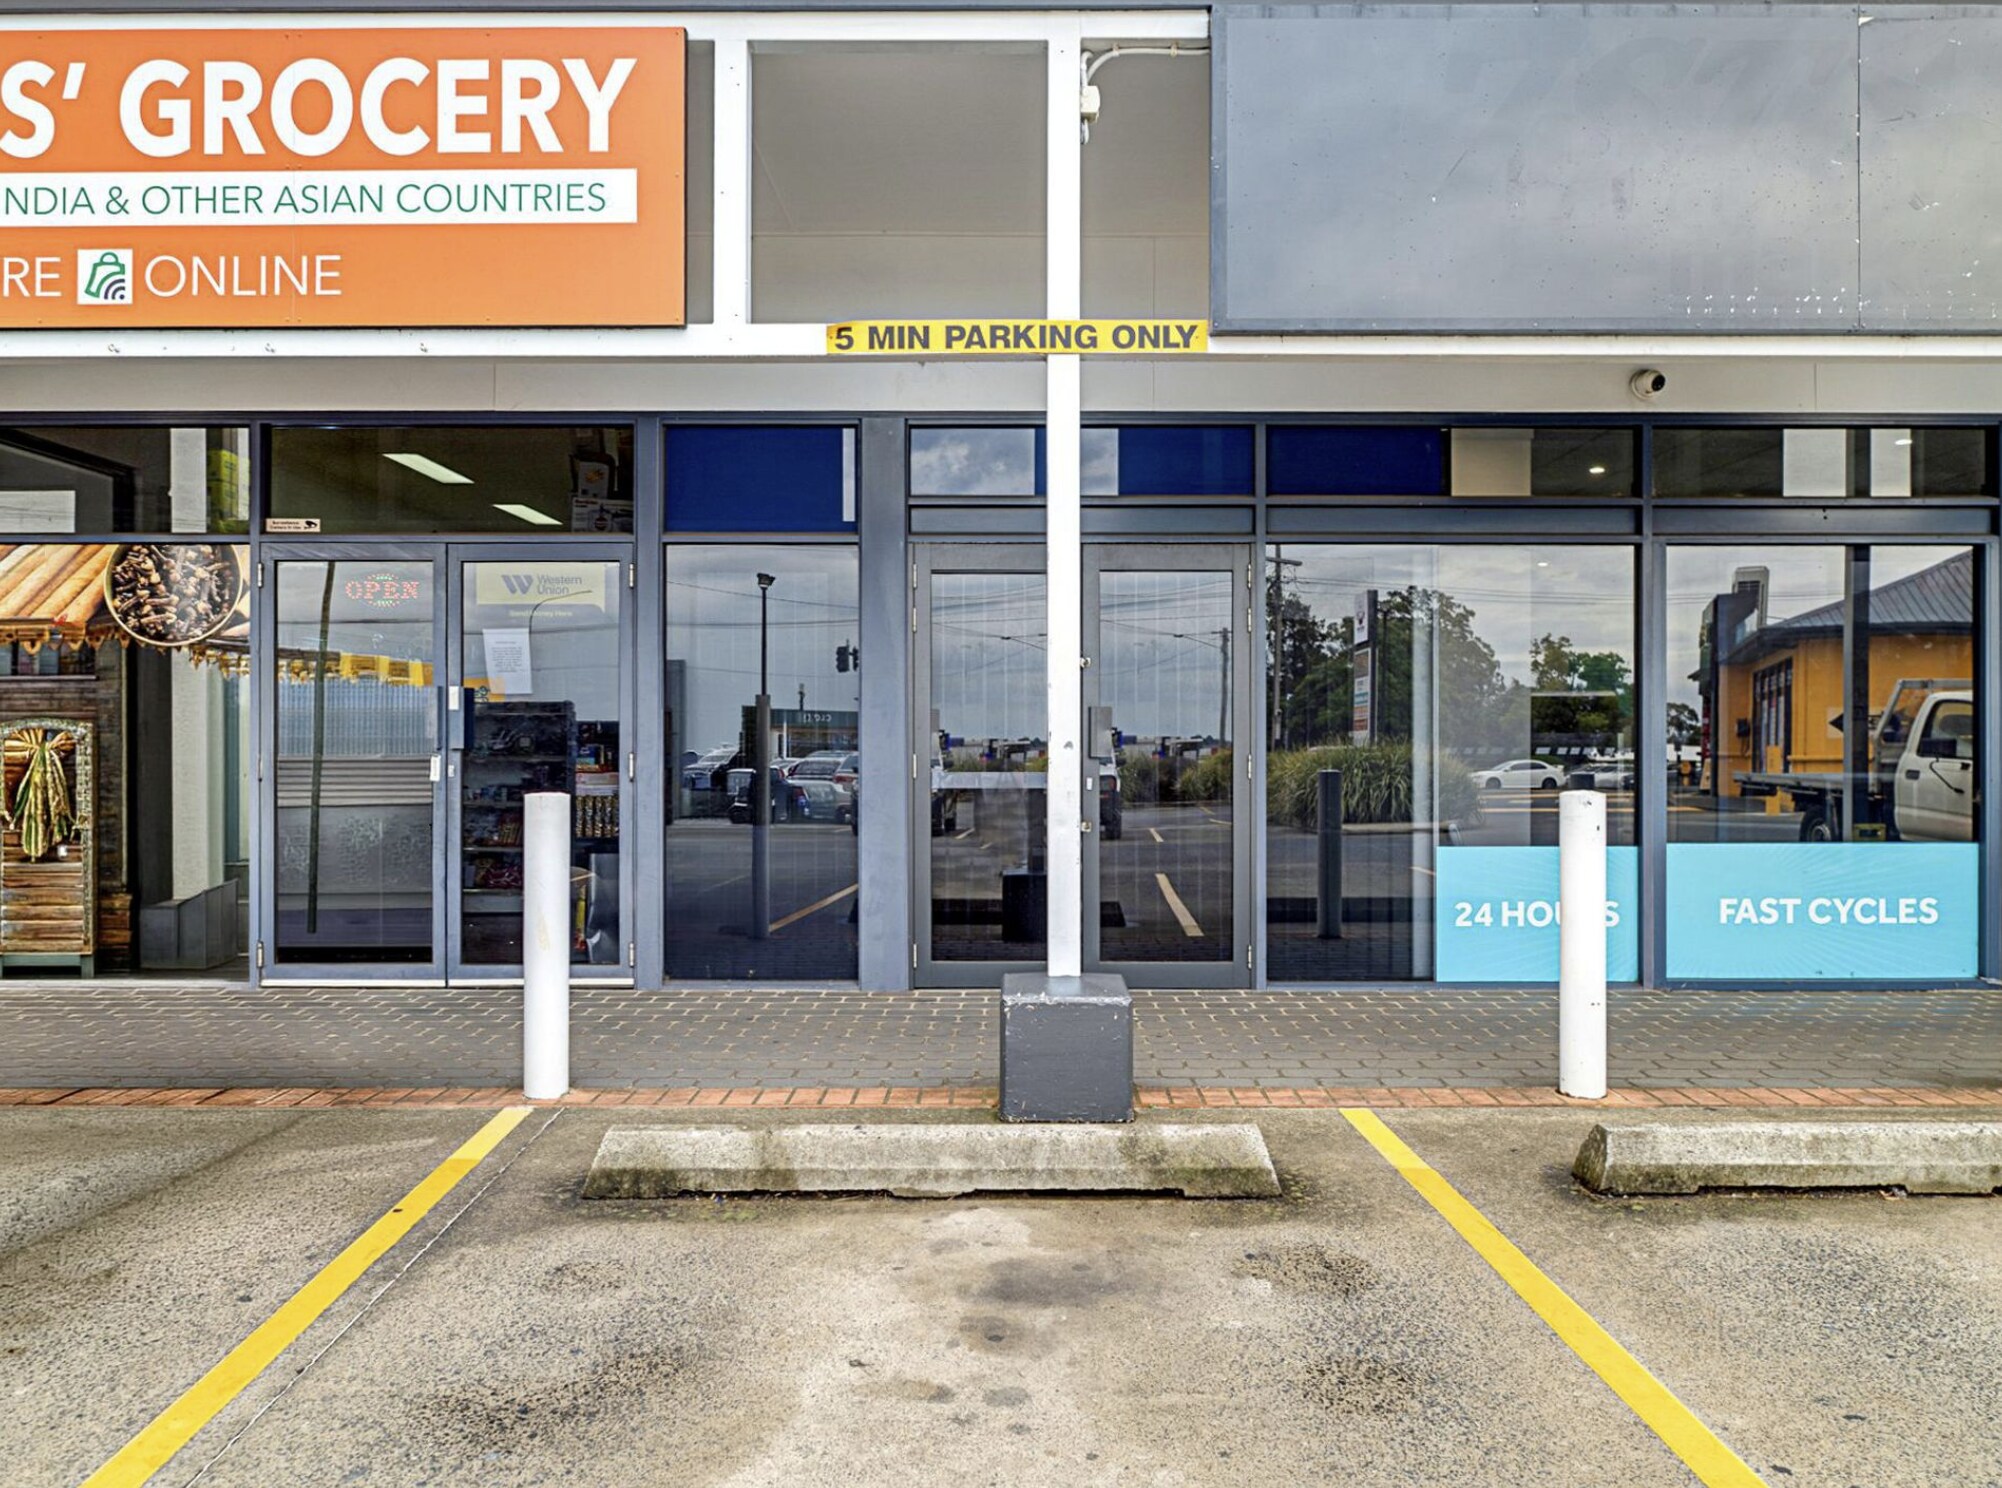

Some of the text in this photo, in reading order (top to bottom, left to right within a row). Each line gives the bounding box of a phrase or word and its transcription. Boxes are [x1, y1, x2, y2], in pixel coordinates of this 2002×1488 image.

[119, 57, 637, 157] GROCERY
[5, 182, 606, 215] NDIA & OTHER ASIAN COUNTRIES
[3, 254, 342, 297] RE ONLINE
[835, 324, 1199, 350] 5 MIN PARKING ONLY
[345, 581, 419, 600] OPEN
[537, 574, 582, 585] Western
[537, 585, 570, 595] Union
[1454, 900, 1620, 928] 24 HOS
[1720, 896, 1939, 926] FAST CYCLES
